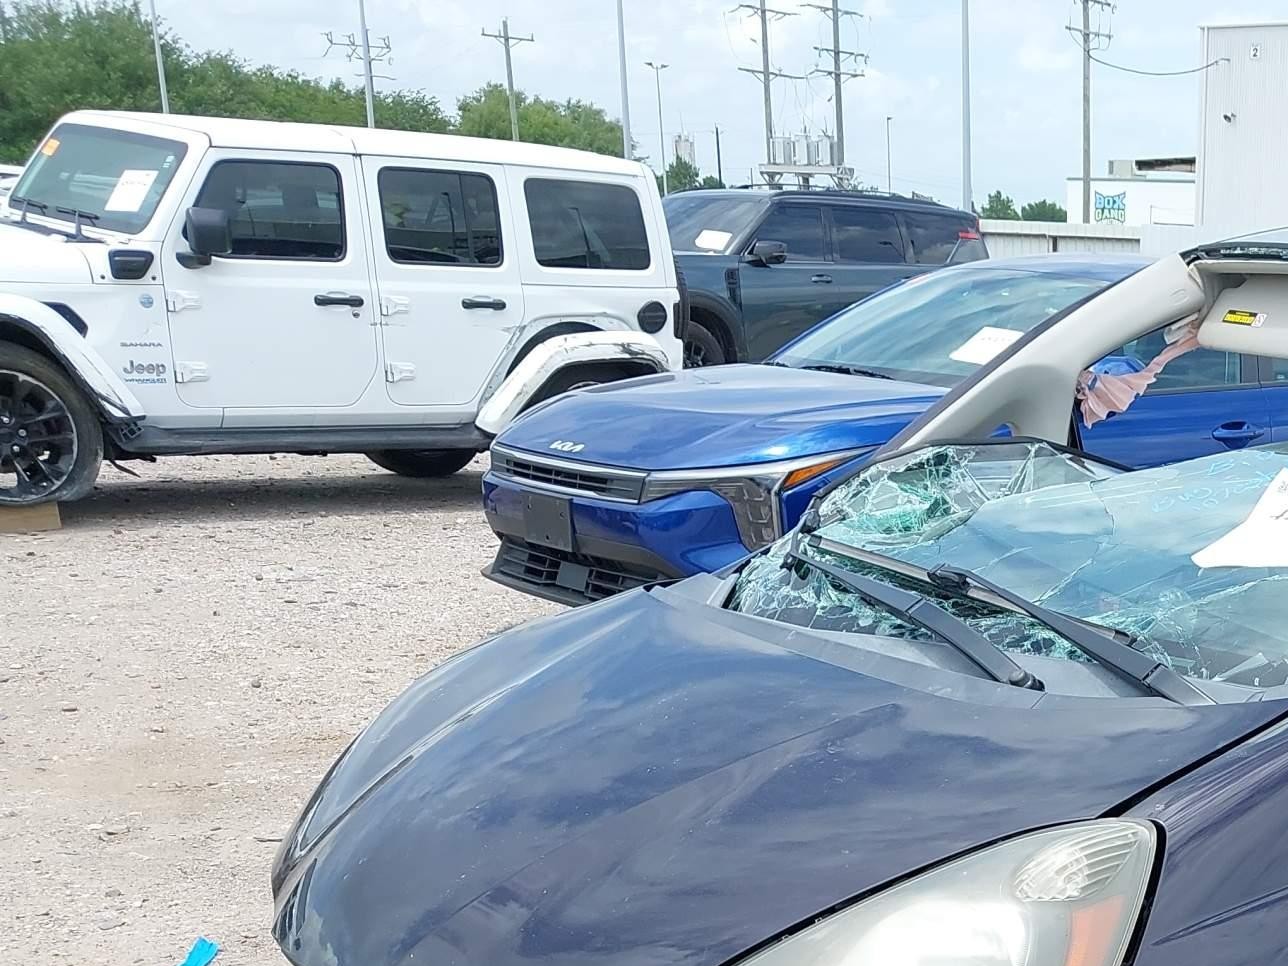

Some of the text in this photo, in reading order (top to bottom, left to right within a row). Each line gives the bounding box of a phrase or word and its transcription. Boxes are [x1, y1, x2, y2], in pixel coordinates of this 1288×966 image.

[1094, 190, 1126, 209] BOX
[123, 360, 167, 377] Jeep
[550, 440, 585, 452] KIA
